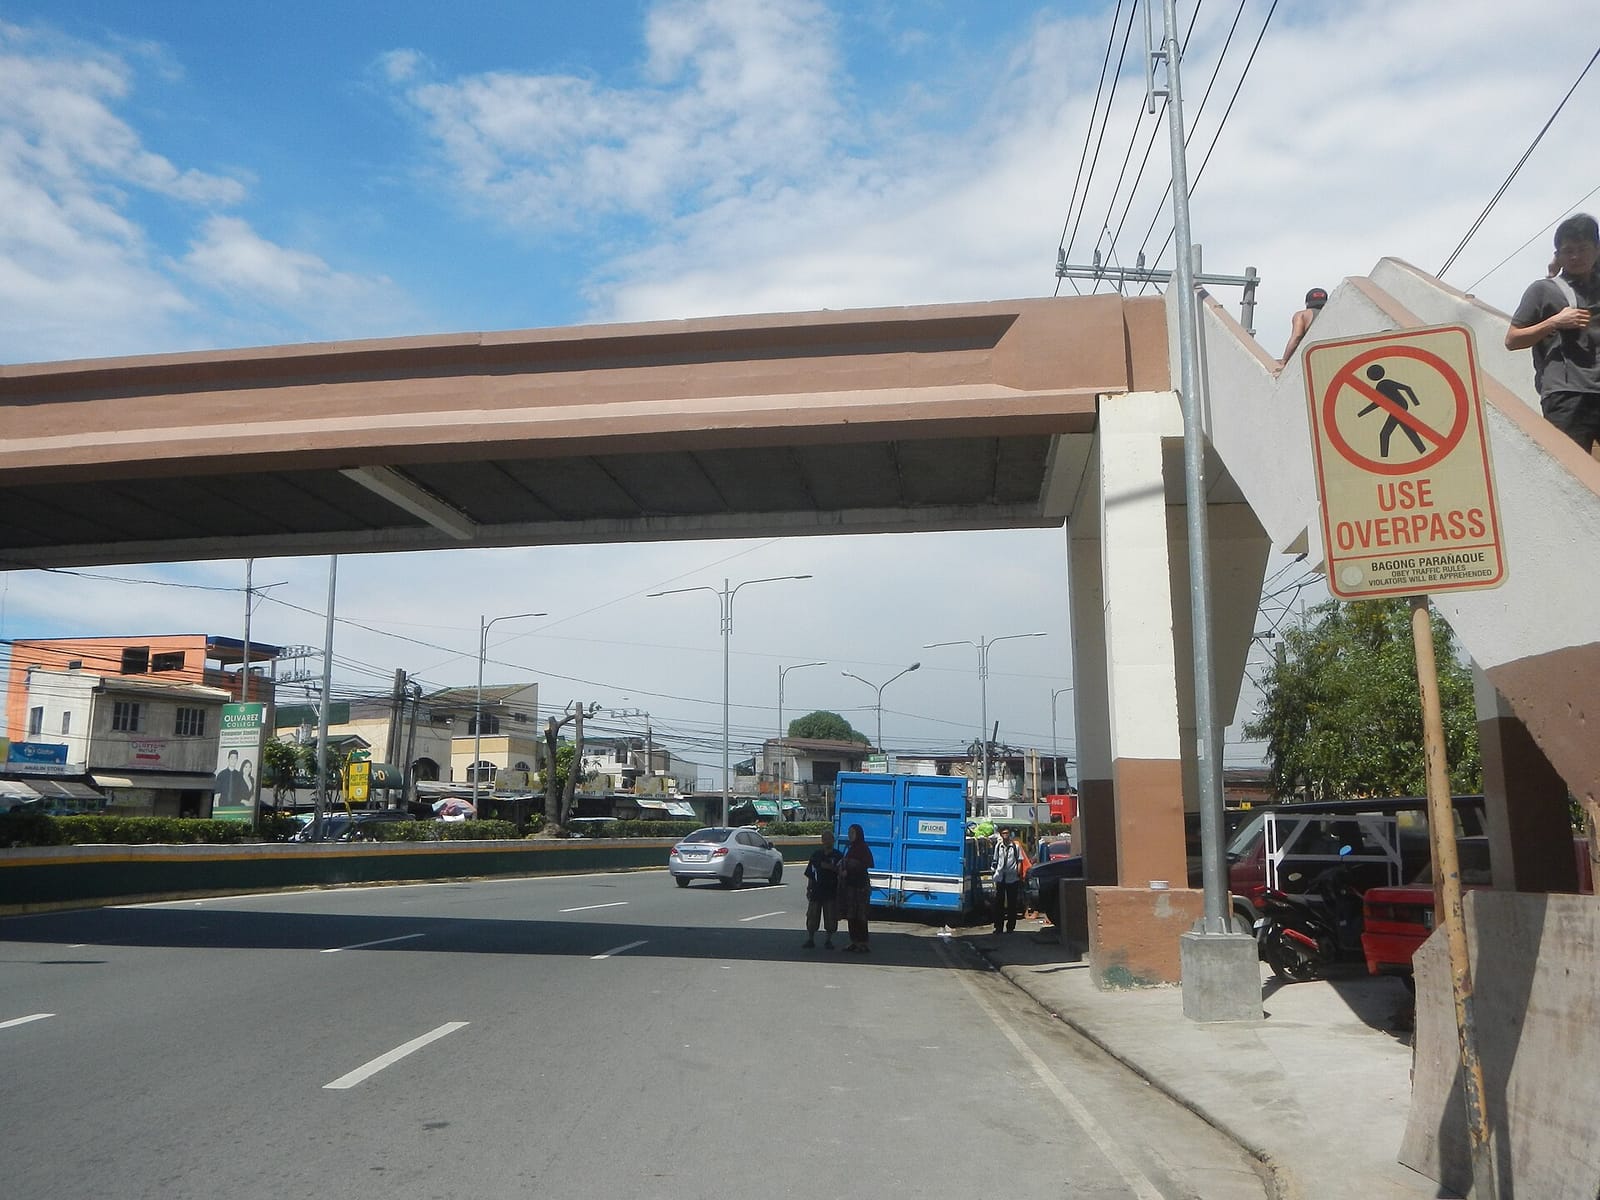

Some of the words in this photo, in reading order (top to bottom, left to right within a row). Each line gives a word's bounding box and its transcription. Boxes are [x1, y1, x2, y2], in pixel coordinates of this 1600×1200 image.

[1377, 479, 1434, 512] USE
[1336, 508, 1486, 550] OVERPASS
[1371, 558, 1415, 572] BAGONG
[1391, 569, 1410, 577] OBEY
[1412, 566, 1441, 576] TRAFFIC
[1442, 564, 1466, 573] RULES
[1368, 577, 1407, 587] VIOLATORS
[1408, 575, 1426, 583] WILL
[1439, 569, 1492, 580] APPREHENDED
[224, 713, 259, 722] OLIVAREZ
